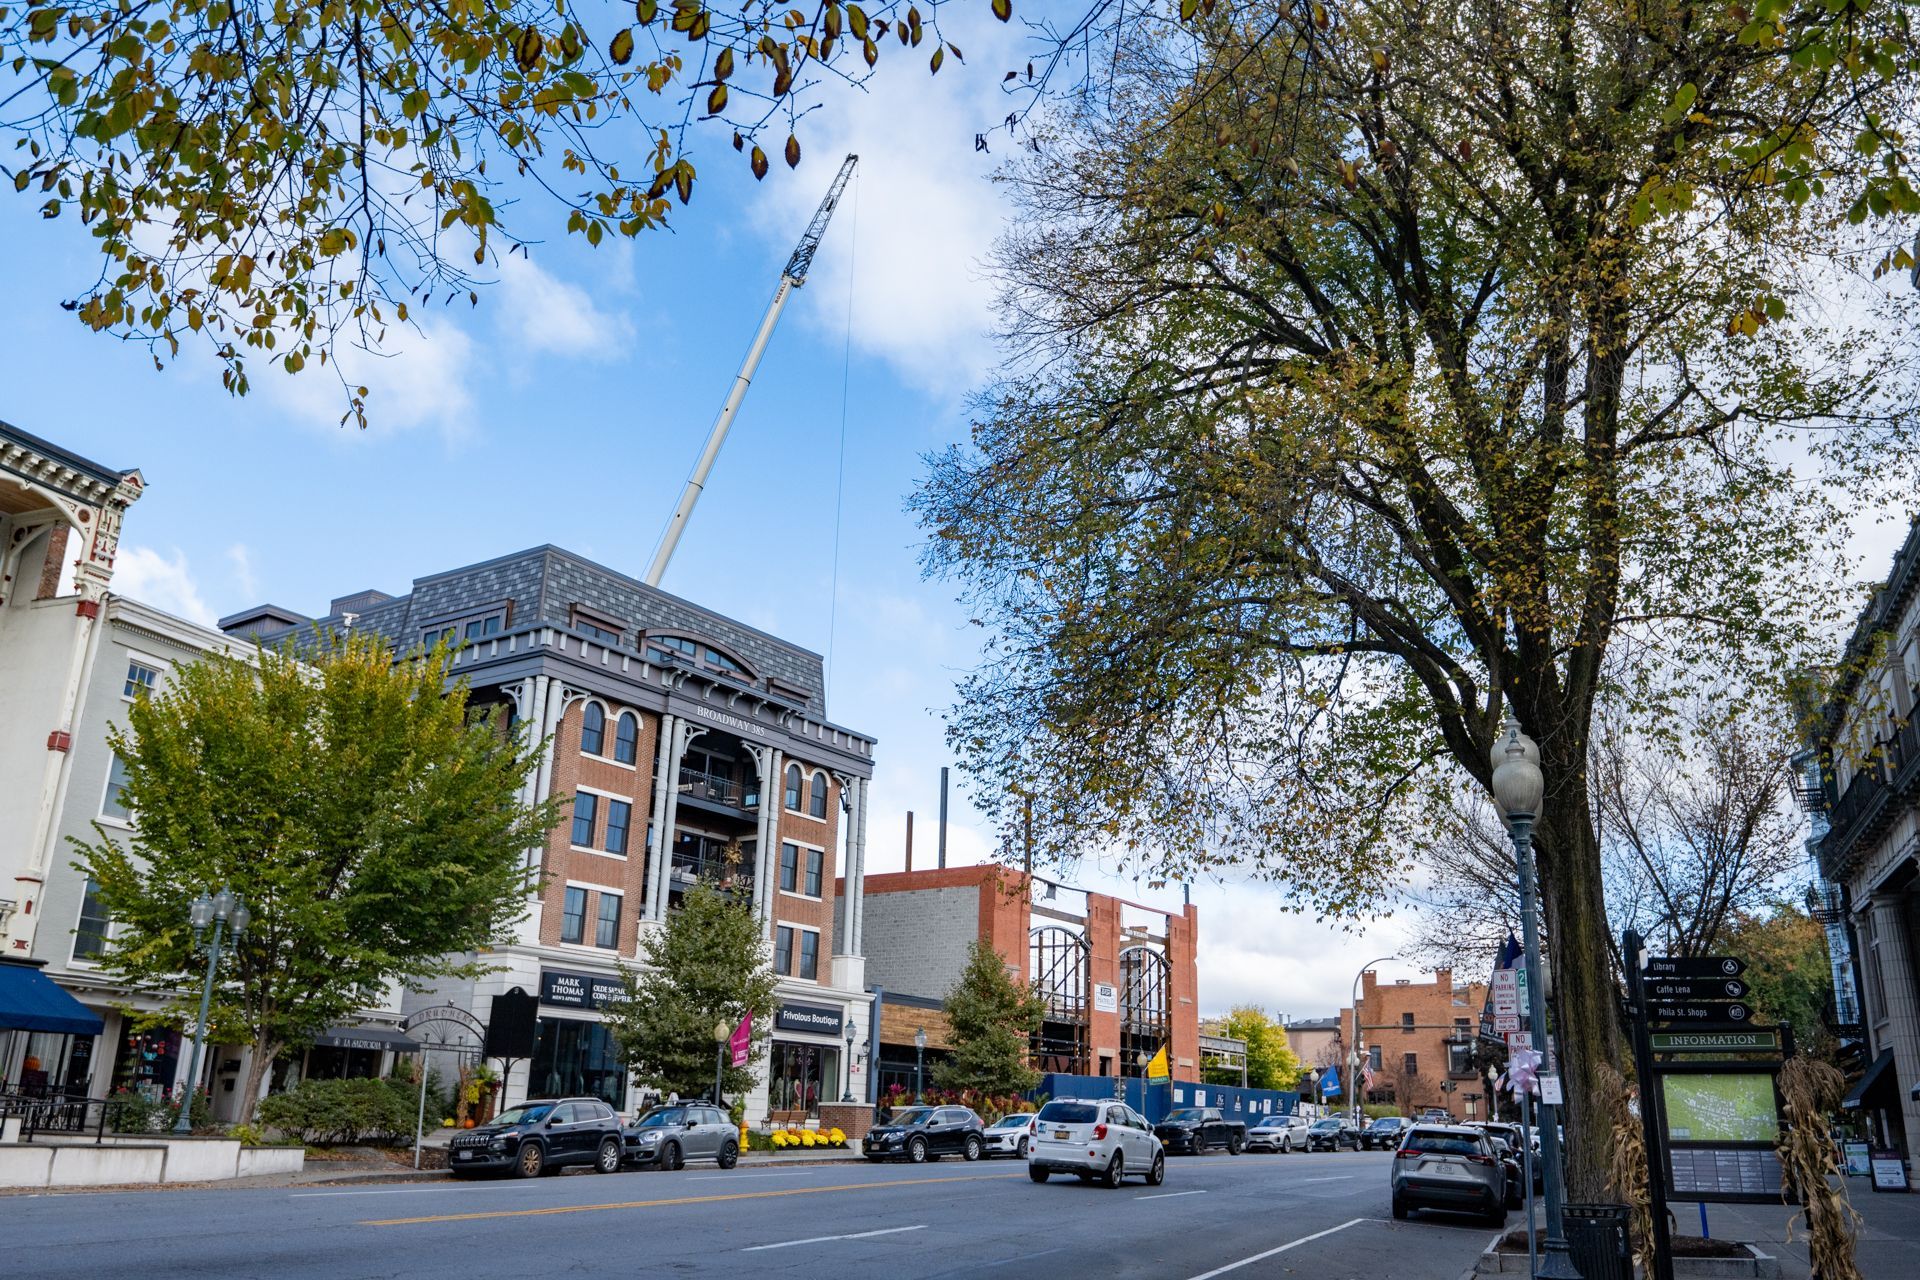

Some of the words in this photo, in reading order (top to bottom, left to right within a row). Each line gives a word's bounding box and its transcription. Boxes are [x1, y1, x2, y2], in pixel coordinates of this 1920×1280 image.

[697, 705, 750, 732] BROADWAY
[751, 724, 765, 737] 385
[1653, 962, 1676, 973] Library
[557, 977, 580, 987] MARK
[1500, 973, 1509, 982] NO
[1518, 972, 1525, 985] 2
[551, 985, 585, 997] THOMAS
[592, 984, 608, 993] OLDE
[1495, 984, 1515, 992] PARKING
[1675, 985, 1691, 994] Lena
[592, 992, 607, 1001] COIN
[783, 1010, 812, 1022] Frivolous
[812, 1013, 839, 1026] Boutique
[1658, 1008, 1676, 1017] Phila
[1677, 1008, 1686, 1017] St.
[1687, 1008, 1708, 1019] Shops
[1515, 1034, 1526, 1044] NO
[1669, 1035, 1757, 1046] INFORMATION
